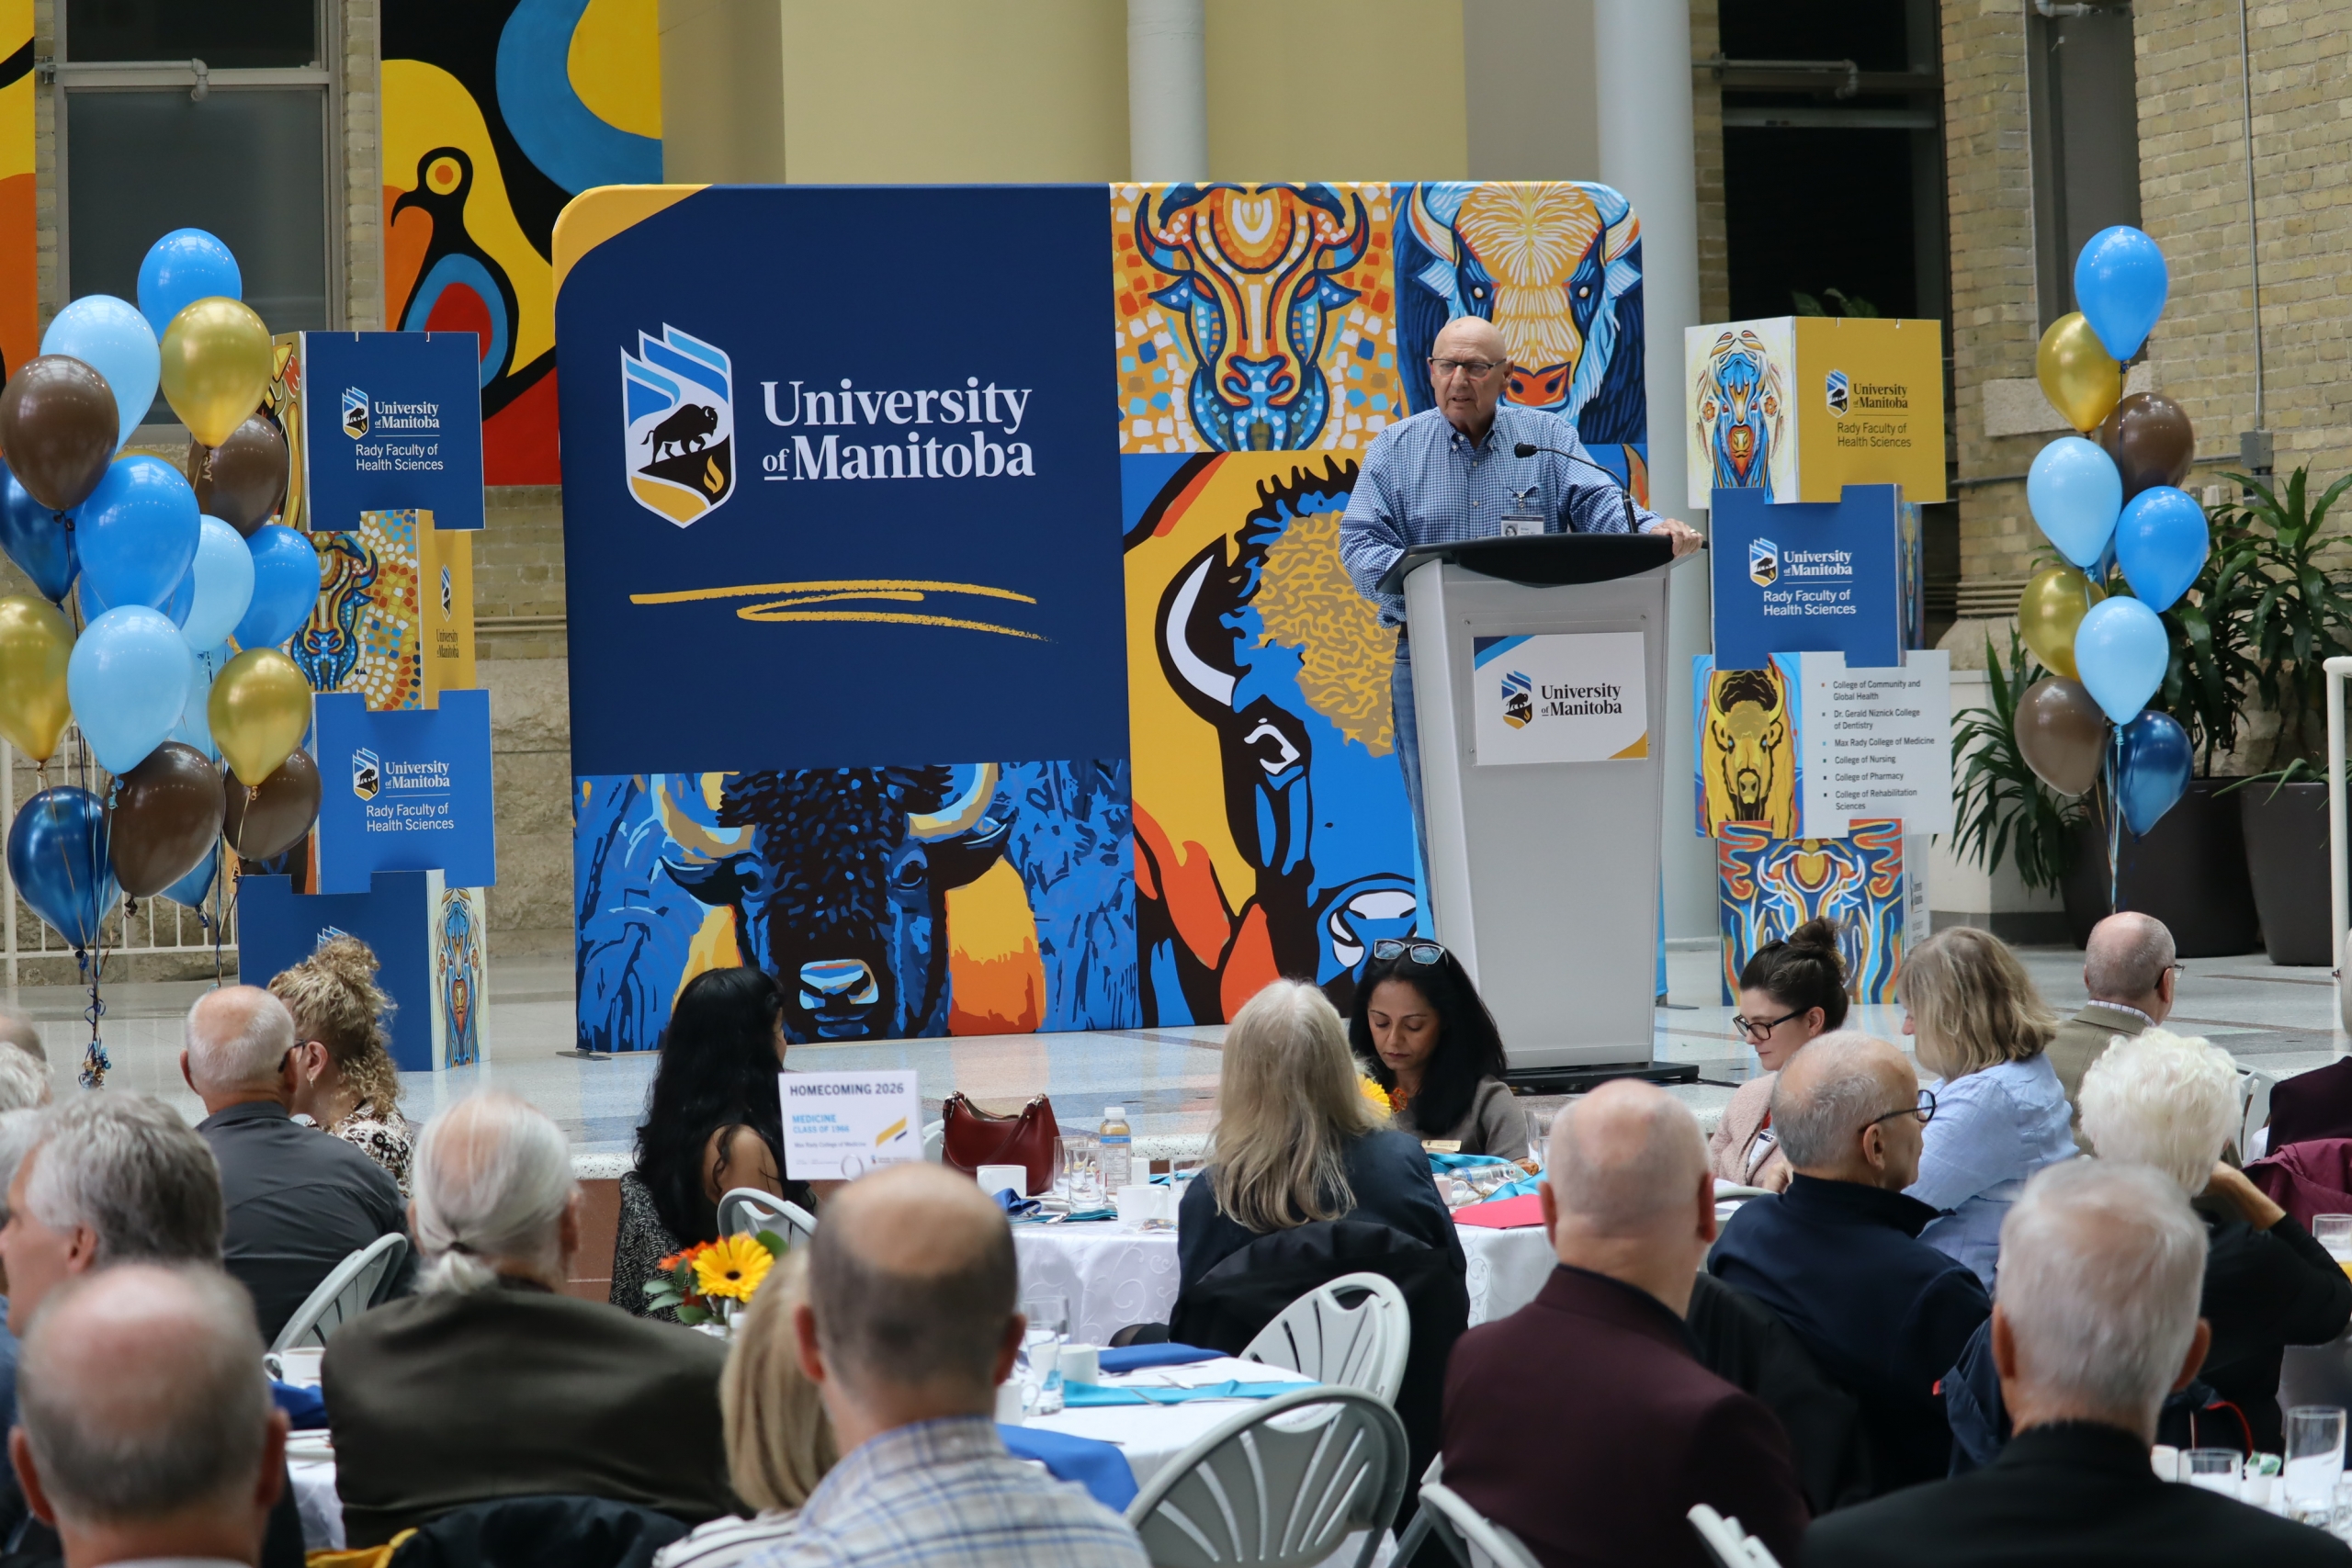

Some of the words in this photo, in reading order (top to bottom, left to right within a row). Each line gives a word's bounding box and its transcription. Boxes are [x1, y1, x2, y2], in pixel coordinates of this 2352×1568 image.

[1853, 384, 1907, 398] University
[375, 401, 439, 416] University
[761, 377, 1033, 434] University
[1860, 397, 1907, 408] Manitoba
[382, 415, 439, 428] Manitoba
[1838, 423, 1860, 435] Rady
[1863, 423, 1895, 435] Faculty
[1898, 423, 1906, 434] of
[1838, 436, 1867, 446] Health
[1871, 436, 1911, 447] Sciences
[356, 444, 383, 457] Rady
[387, 444, 424, 457] Faculty
[427, 444, 437, 456] of
[763, 448, 789, 472] of
[792, 431, 1035, 480] Manitoba
[356, 459, 391, 470] Health
[395, 458, 443, 470] Sciences
[1783, 550, 1852, 564] University
[1792, 563, 1852, 576] Manitoba
[1764, 591, 1792, 604] Rady
[1796, 591, 1836, 603] Faculty
[1839, 590, 1850, 600] of
[1764, 604, 1802, 615] Health
[1804, 604, 1856, 615] Sciences
[436, 629, 458, 646] University
[439, 644, 458, 659] Manitoba
[1542, 682, 1622, 699] University
[1833, 681, 1858, 689] College
[1834, 693, 1854, 701] Global
[1551, 700, 1622, 716] Manitoba
[1895, 709, 1920, 717] College
[1843, 722, 1872, 730] Dentistry
[1850, 739, 1867, 747] Rady
[1904, 737, 1934, 745] Medicine
[1835, 756, 1860, 764] College
[1870, 756, 1895, 764] Nursing
[385, 761, 449, 775] University
[392, 775, 450, 788] Manitoba
[1836, 773, 1860, 782] College
[1871, 773, 1904, 781] Pharmacy
[1836, 791, 1860, 799] College
[1871, 789, 1917, 797] Rehabilitation
[367, 805, 393, 818] Rady
[397, 804, 435, 818] Faculty
[437, 803, 448, 814] of
[367, 820, 402, 832] Health
[405, 819, 454, 830] Sciences
[790, 1084, 872, 1096] HOMECOMING
[876, 1083, 904, 1094] 2026
[792, 1114, 836, 1123] MEDICINE
